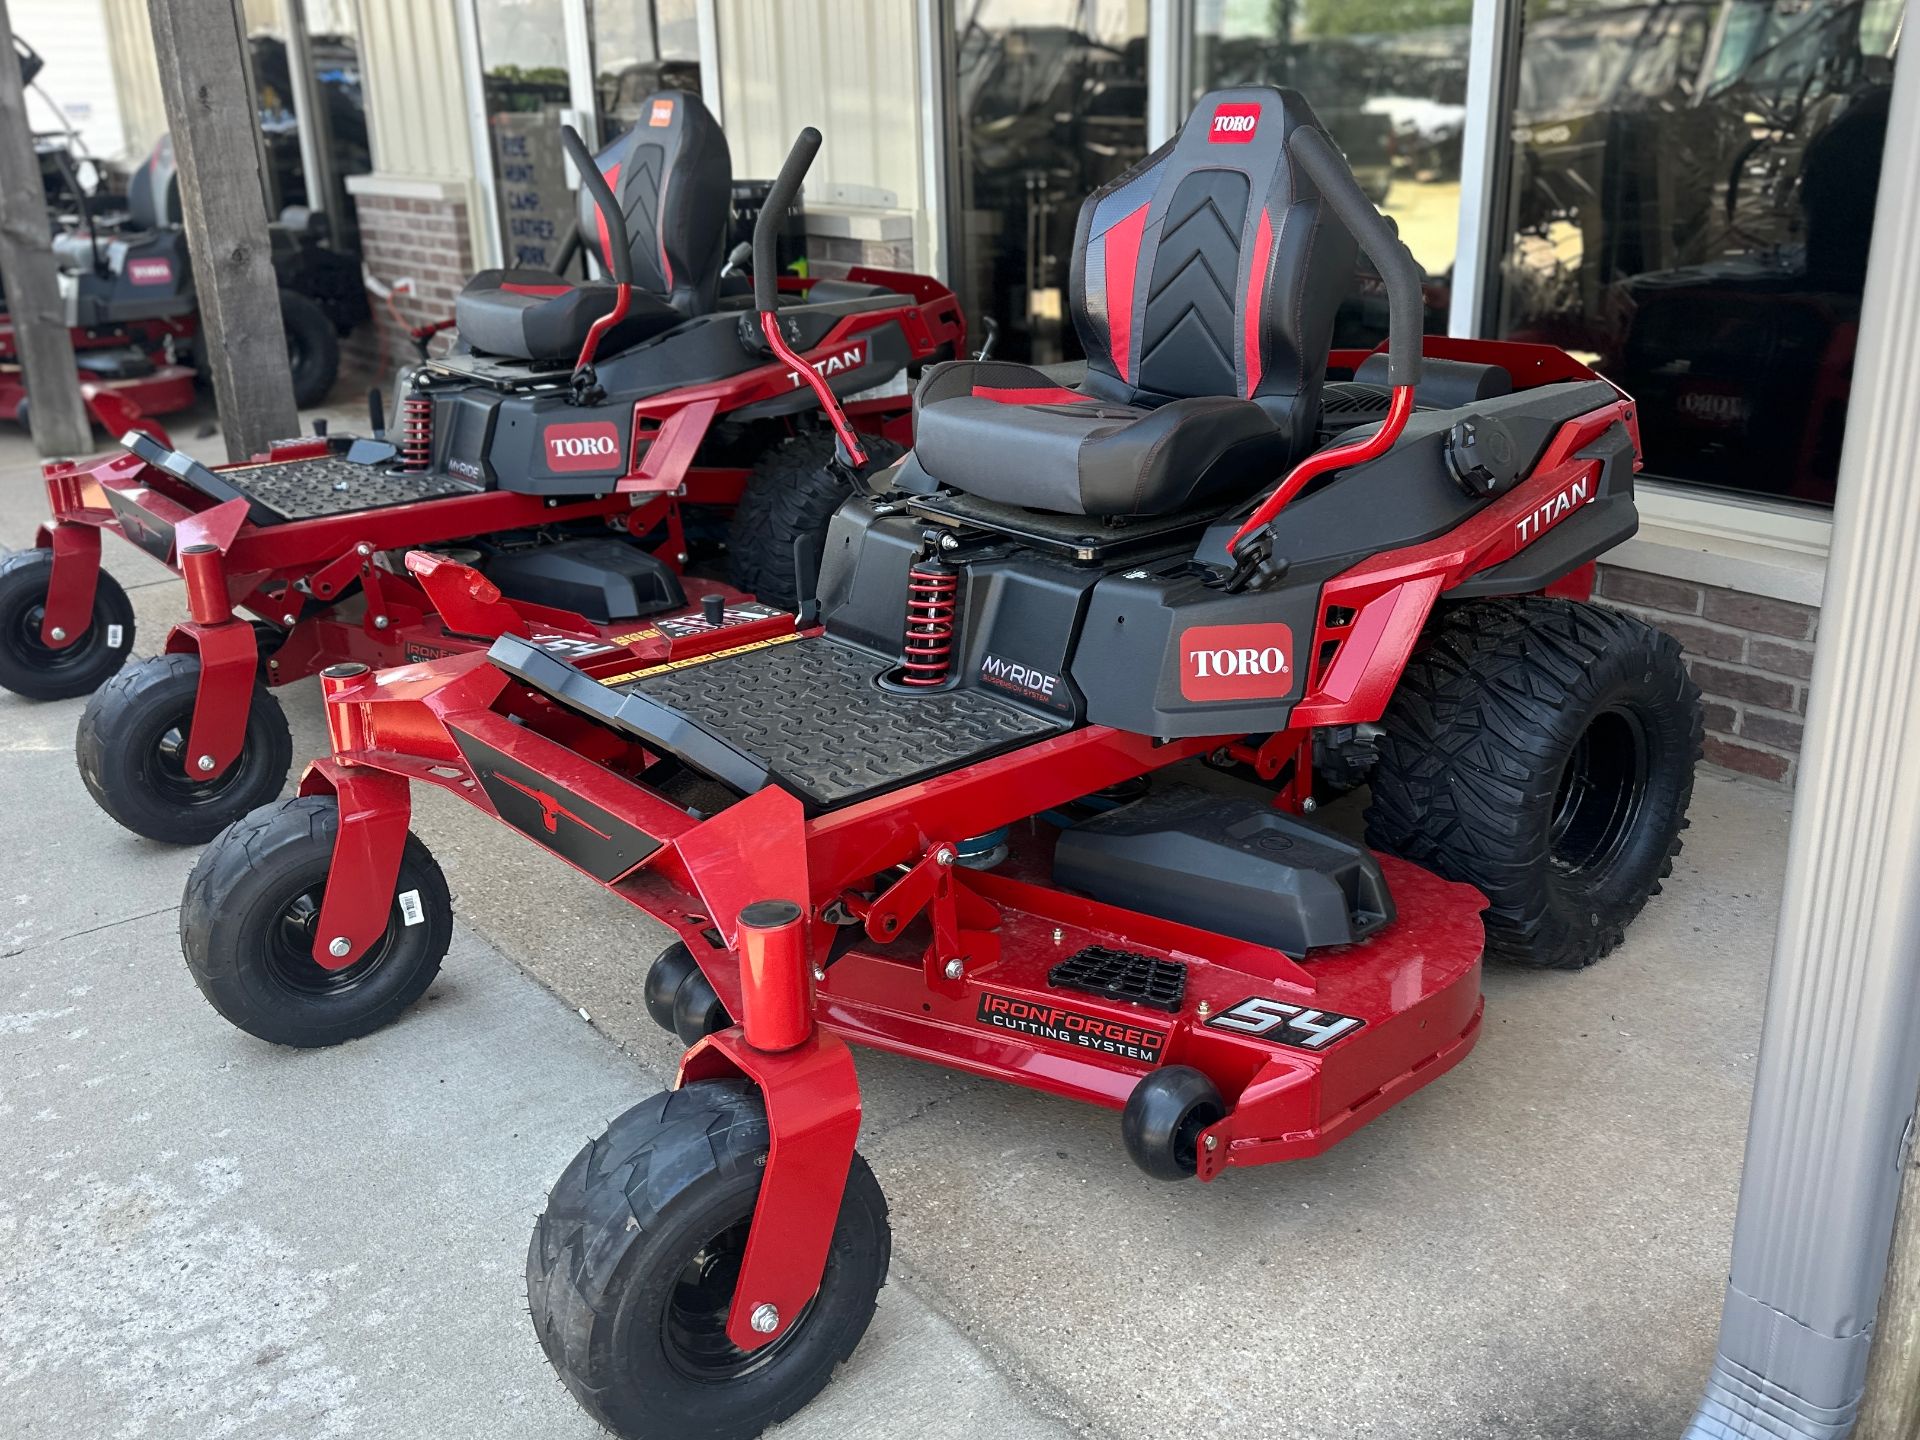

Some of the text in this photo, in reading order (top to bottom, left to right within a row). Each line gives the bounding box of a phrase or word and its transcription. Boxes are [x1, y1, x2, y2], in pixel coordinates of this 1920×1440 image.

[1214, 115, 1255, 132] TORO
[786, 347, 862, 388] TTAN
[550, 436, 614, 457] TORO
[1516, 476, 1587, 542] TITAN
[1190, 647, 1285, 677] TORO
[982, 674, 1049, 703] SUSPENSION SYSTEM
[984, 995, 1163, 1049] IRONFORGED
[993, 1015, 1153, 1062] CUTTING SYSTEM
[1211, 998, 1359, 1047] 54
